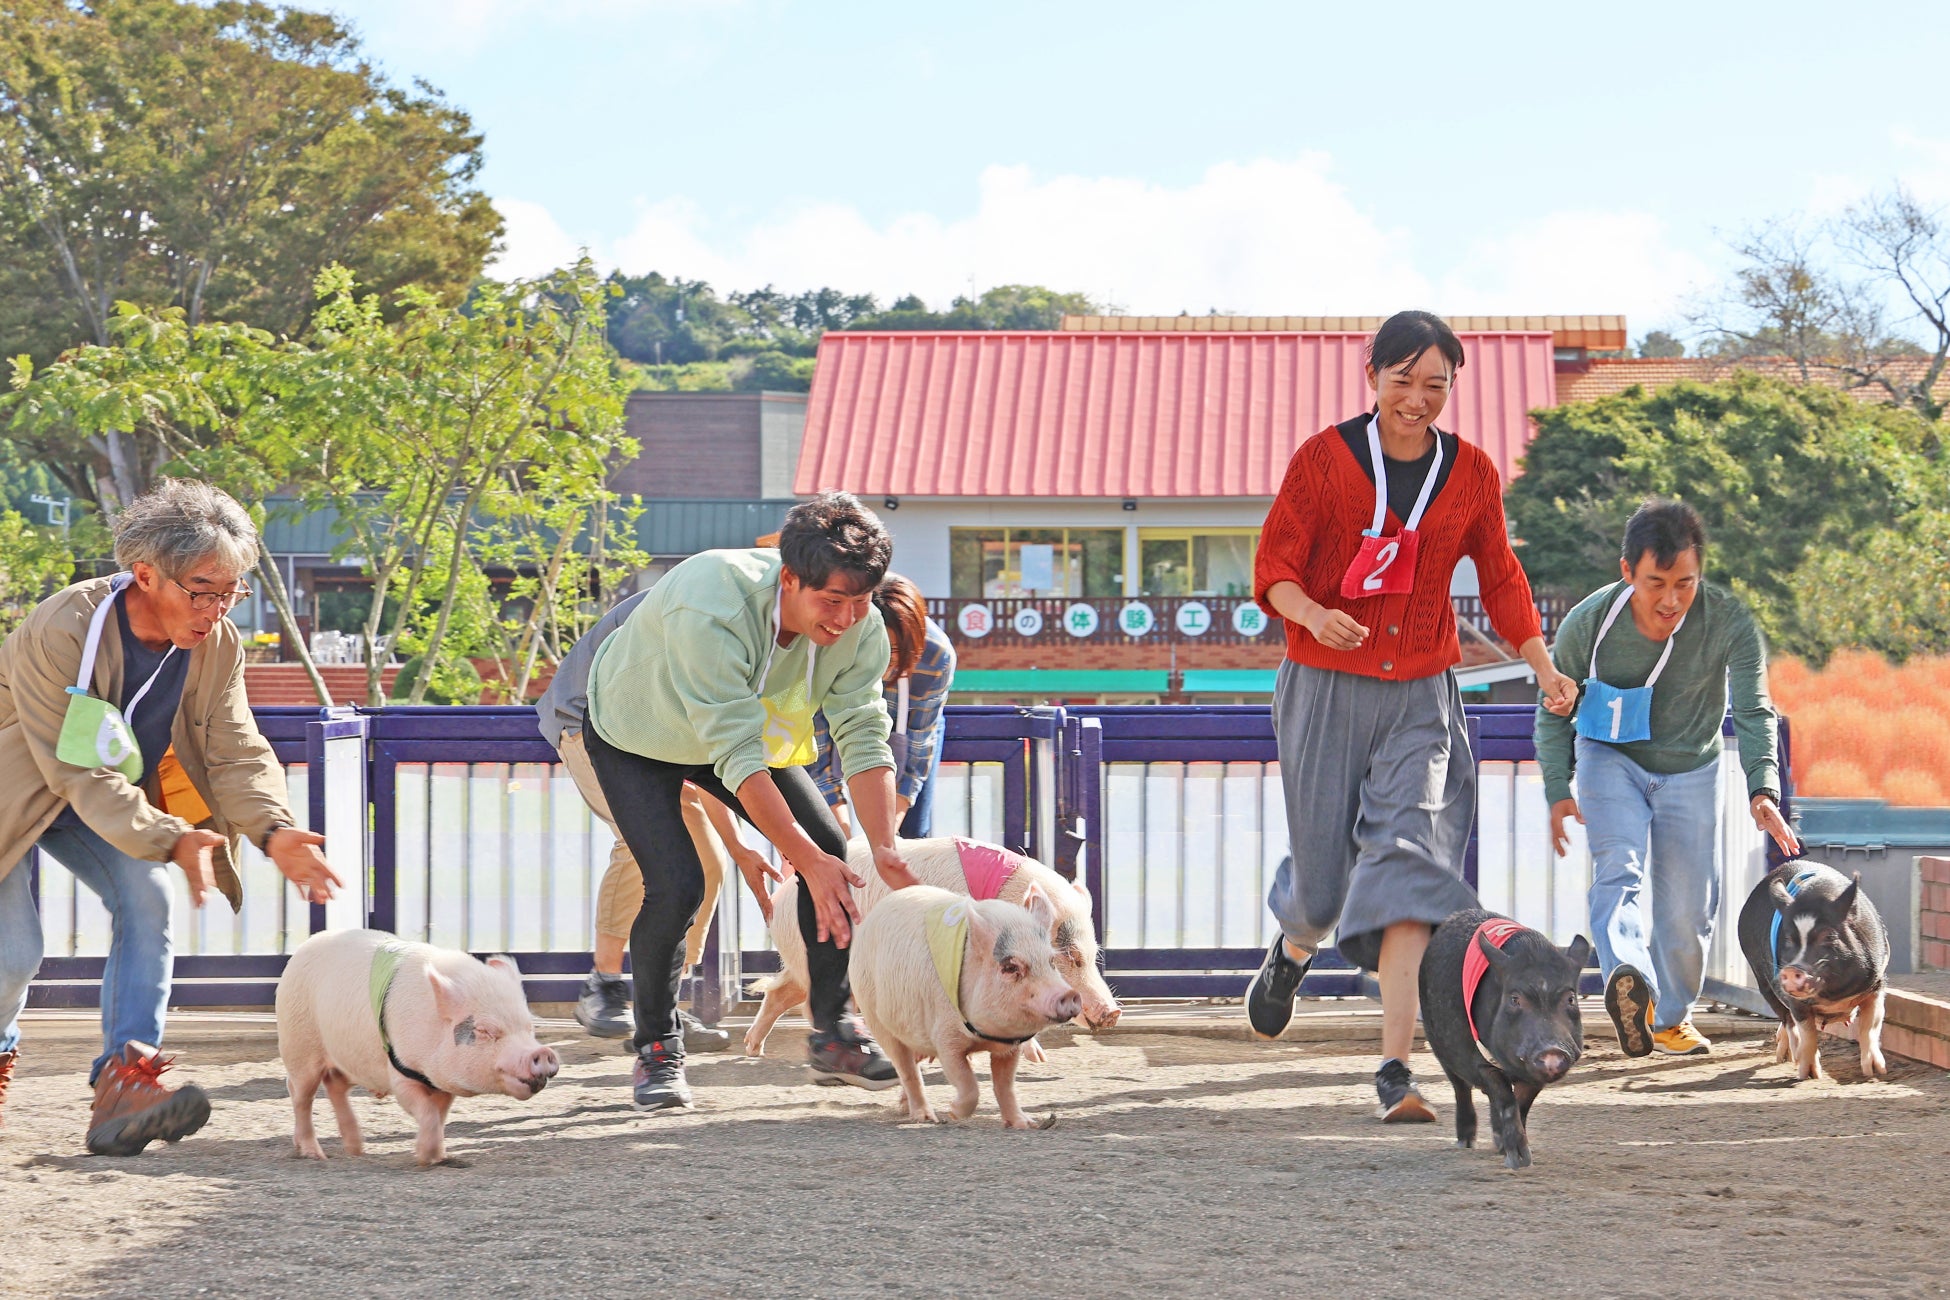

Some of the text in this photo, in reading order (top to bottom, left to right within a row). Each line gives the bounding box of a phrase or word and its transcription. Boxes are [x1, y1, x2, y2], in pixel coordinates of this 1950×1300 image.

[1363, 541, 1399, 591] 2
[965, 608, 1259, 631] 食の体験工房
[762, 712, 795, 763] 5
[1607, 696, 1623, 740] 1
